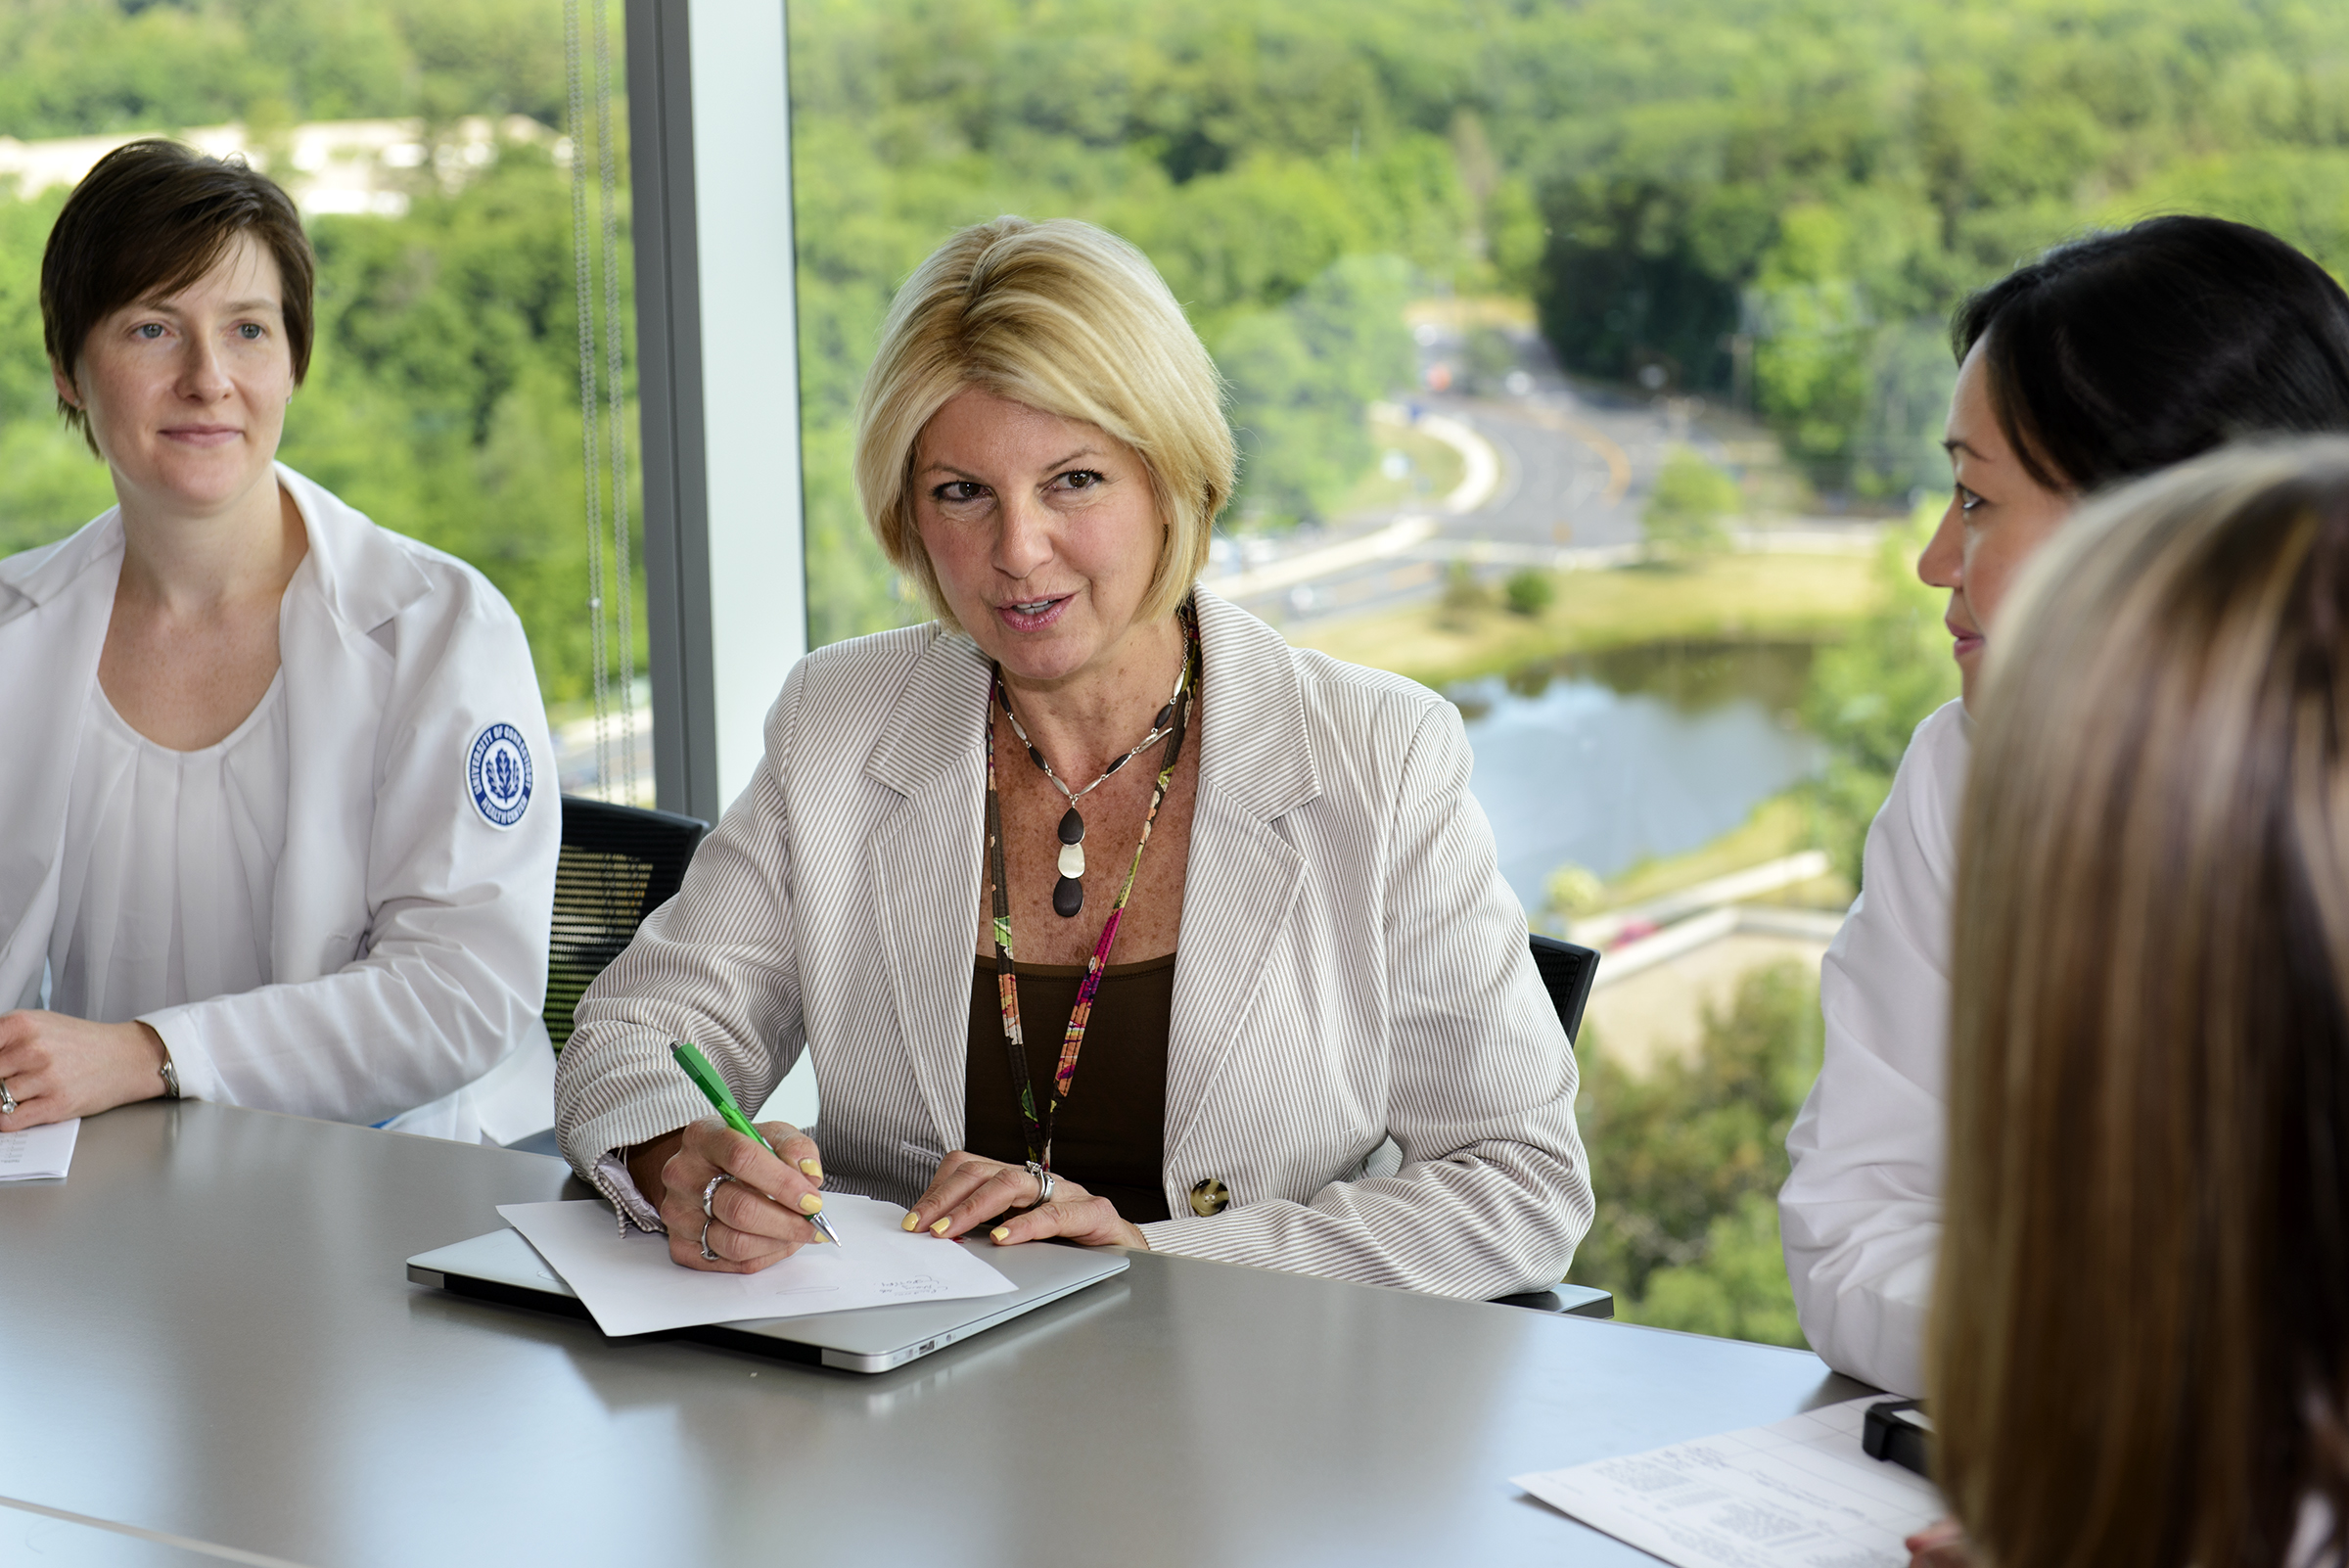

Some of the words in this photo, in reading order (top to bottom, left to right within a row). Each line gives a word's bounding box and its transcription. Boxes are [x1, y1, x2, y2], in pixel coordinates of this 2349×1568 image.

[472, 730, 493, 795] UNIVERSITY
[493, 725, 503, 740] OF
[504, 725, 531, 790] CONNECTICUT
[480, 797, 507, 825] HEALTH
[506, 794, 529, 825] CENTER
